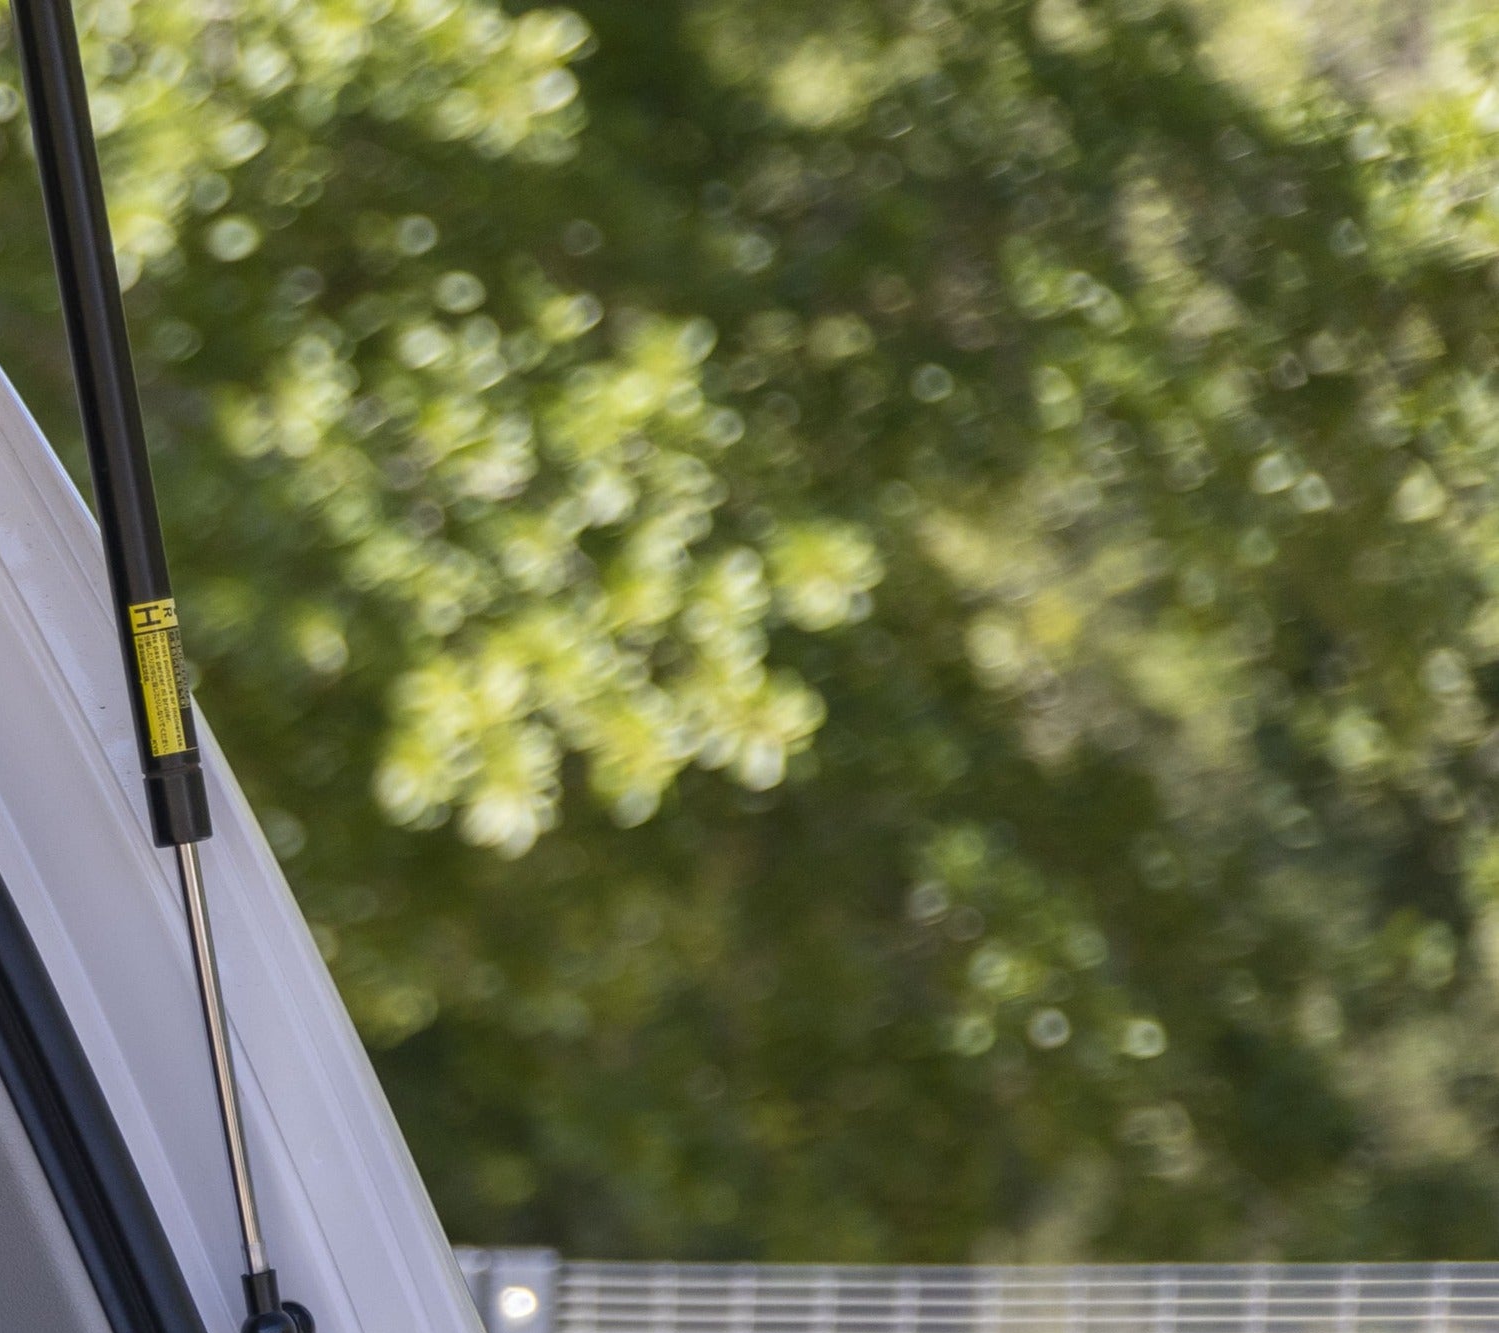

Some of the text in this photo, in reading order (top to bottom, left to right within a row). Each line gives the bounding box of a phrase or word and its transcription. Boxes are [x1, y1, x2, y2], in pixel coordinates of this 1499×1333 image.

[134, 605, 161, 628] H
[163, 607, 172, 617] R
[159, 632, 166, 643] Do
[163, 660, 174, 694] puncture
[170, 697, 177, 706] or
